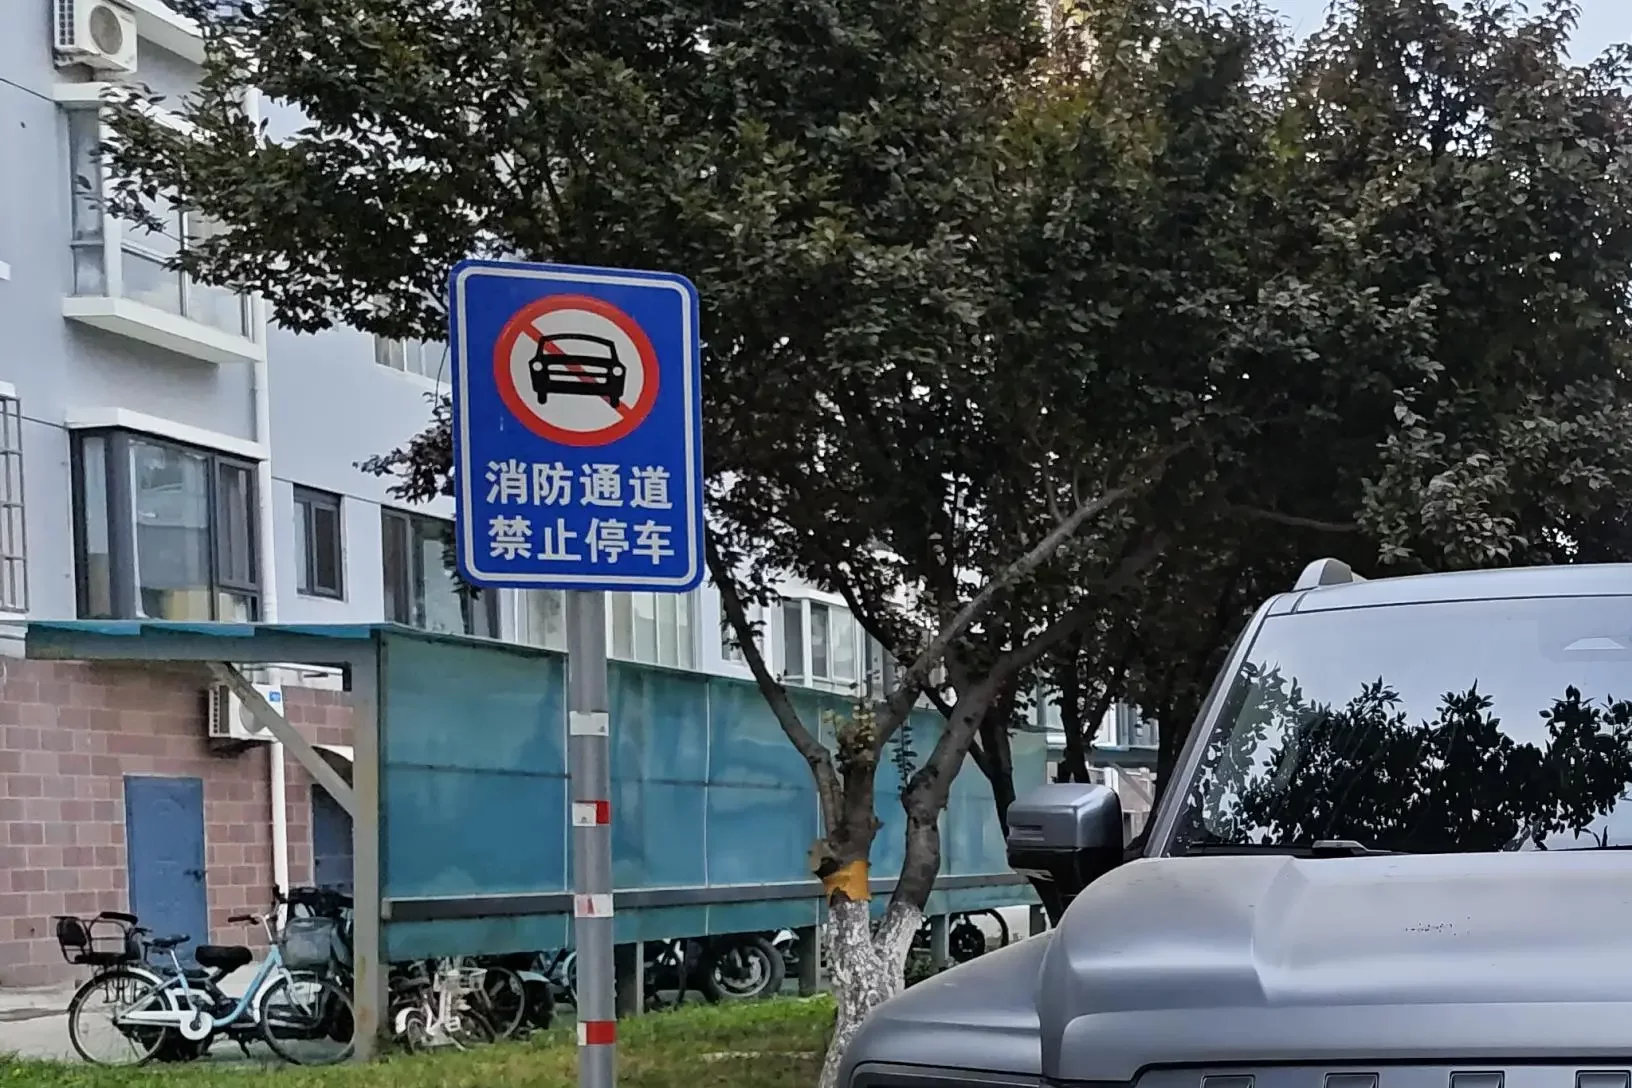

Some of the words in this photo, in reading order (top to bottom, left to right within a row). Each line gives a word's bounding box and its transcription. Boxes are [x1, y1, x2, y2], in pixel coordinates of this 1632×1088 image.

[484, 458, 673, 510] 消防通道
[488, 514, 675, 565] 禁止停车
